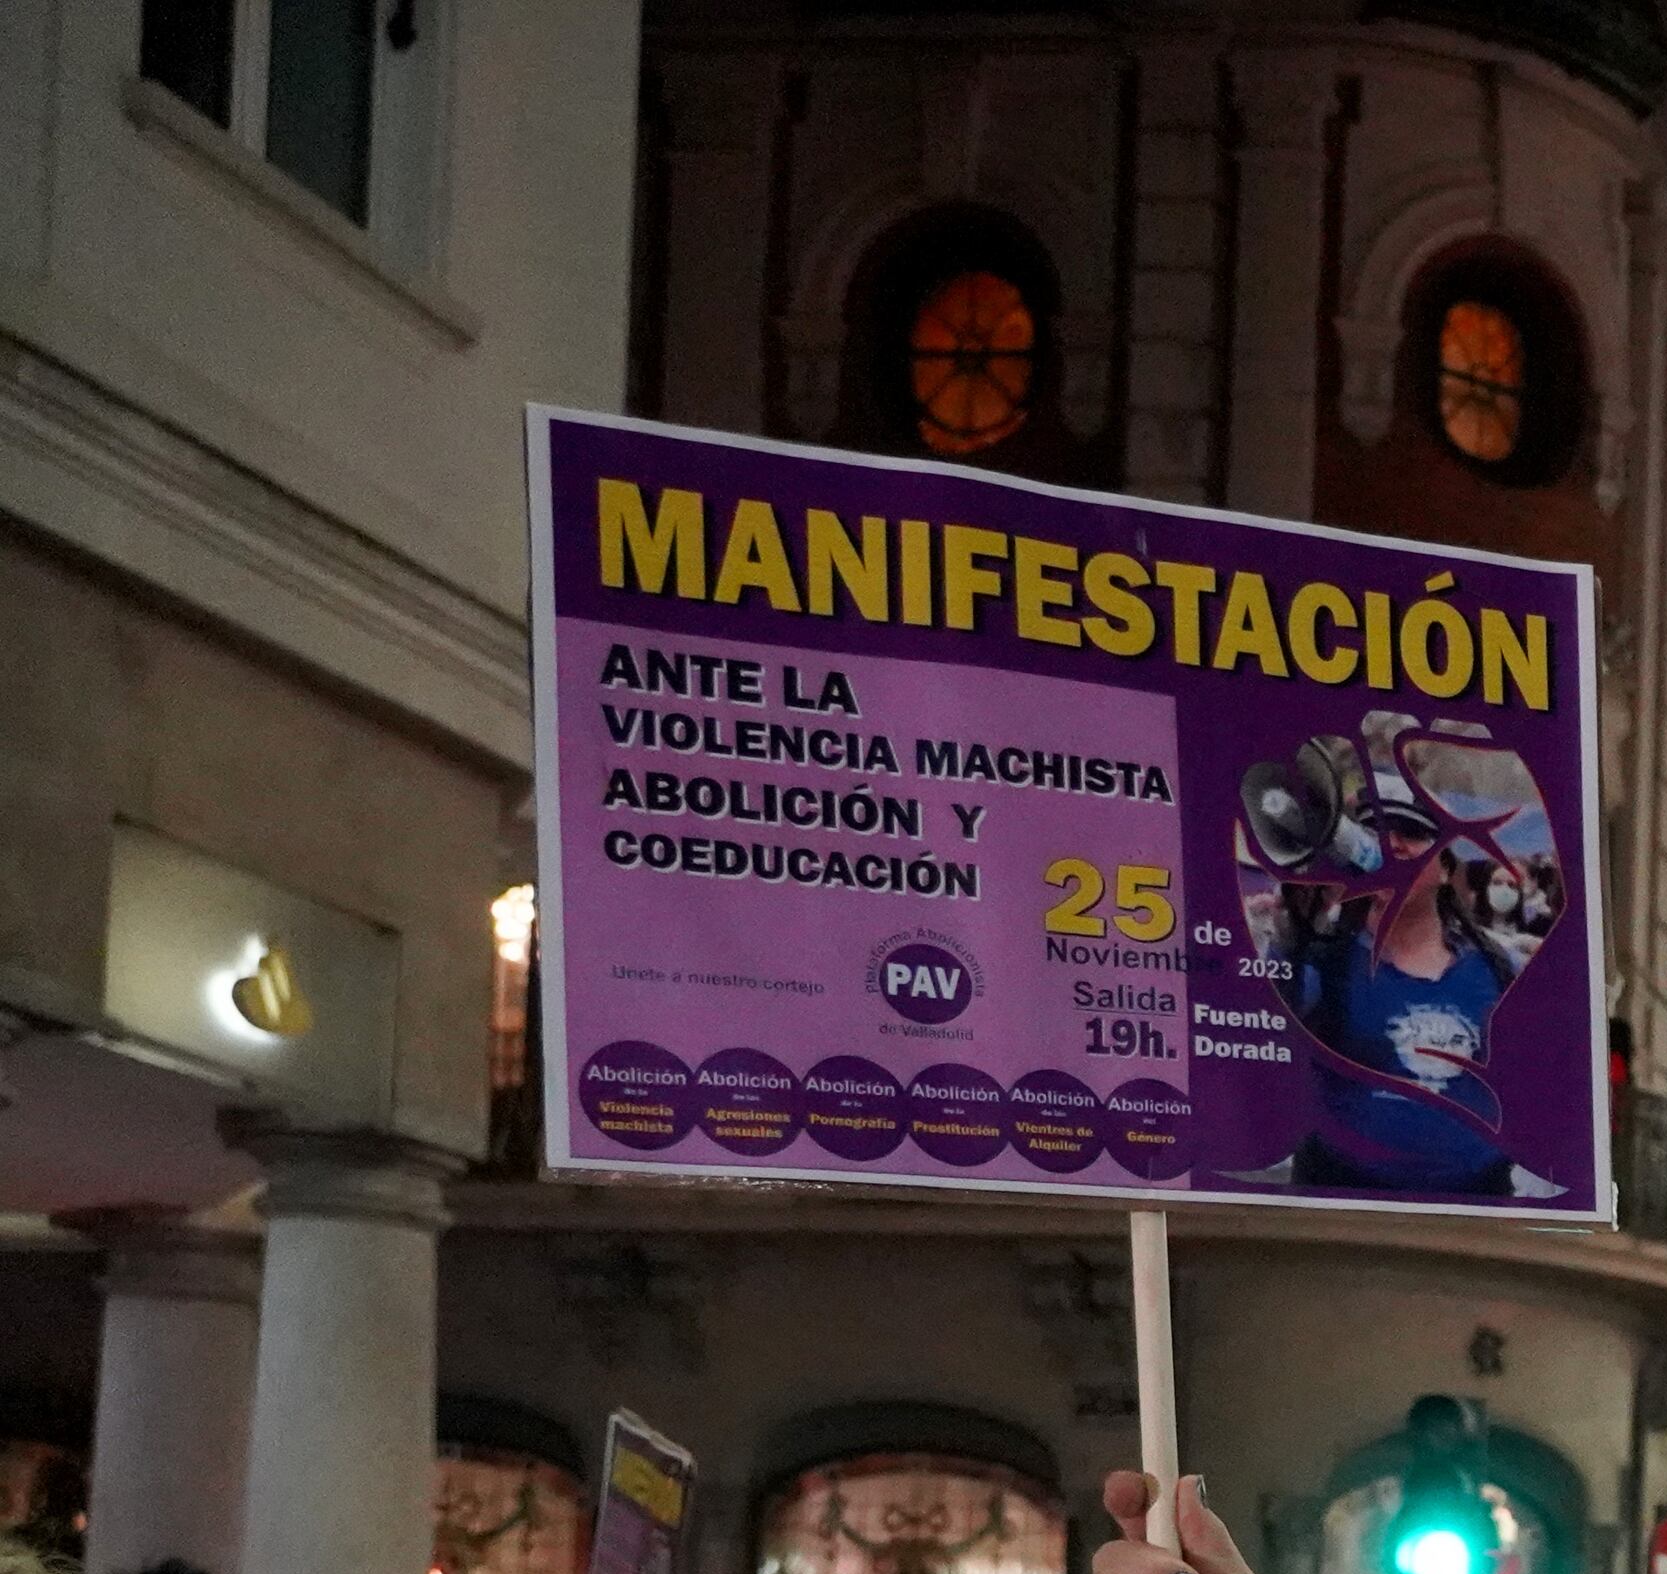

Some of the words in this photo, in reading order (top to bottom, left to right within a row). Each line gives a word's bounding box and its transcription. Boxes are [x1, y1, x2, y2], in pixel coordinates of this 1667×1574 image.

[598, 478, 1551, 712] MANIFESTACIÓN
[601, 644, 765, 707] ANTE
[783, 665, 860, 718] LA
[602, 704, 900, 777] VIOLENCIA
[915, 739, 1175, 805] MACHISTA
[603, 768, 922, 839] ABOLICIÓN
[951, 803, 984, 841] Y
[603, 830, 982, 900] COEDUCACIÓN
[1044, 858, 1176, 943] 25
[1194, 920, 1232, 946] de
[1046, 937, 1222, 976] Noviemb
[1238, 958, 1293, 981] 2023
[672, 969, 682, 983] a
[688, 970, 757, 990] nuestro
[762, 976, 825, 995] cortejo
[886, 962, 961, 1001] PAV
[1073, 980, 1176, 1012] Salida
[1194, 1003, 1287, 1031] Fuente
[1085, 1016, 1178, 1061] 19h.
[1194, 1034, 1292, 1064] Dorada
[587, 1065, 687, 1087] Abolición
[698, 1070, 792, 1091] Abolición
[805, 1077, 896, 1098] Abolición
[911, 1083, 1000, 1103] Abolición
[1011, 1088, 1095, 1108] Abolición
[600, 1101, 674, 1118] Violencia
[706, 1107, 791, 1124] Agresiones
[1108, 1097, 1192, 1116] Abolición
[600, 1119, 674, 1134] machista
[715, 1125, 783, 1139] sexuales
[1016, 1122, 1074, 1137] Vientres
[1077, 1125, 1094, 1137] de
[1029, 1137, 1082, 1152] Alquiler
